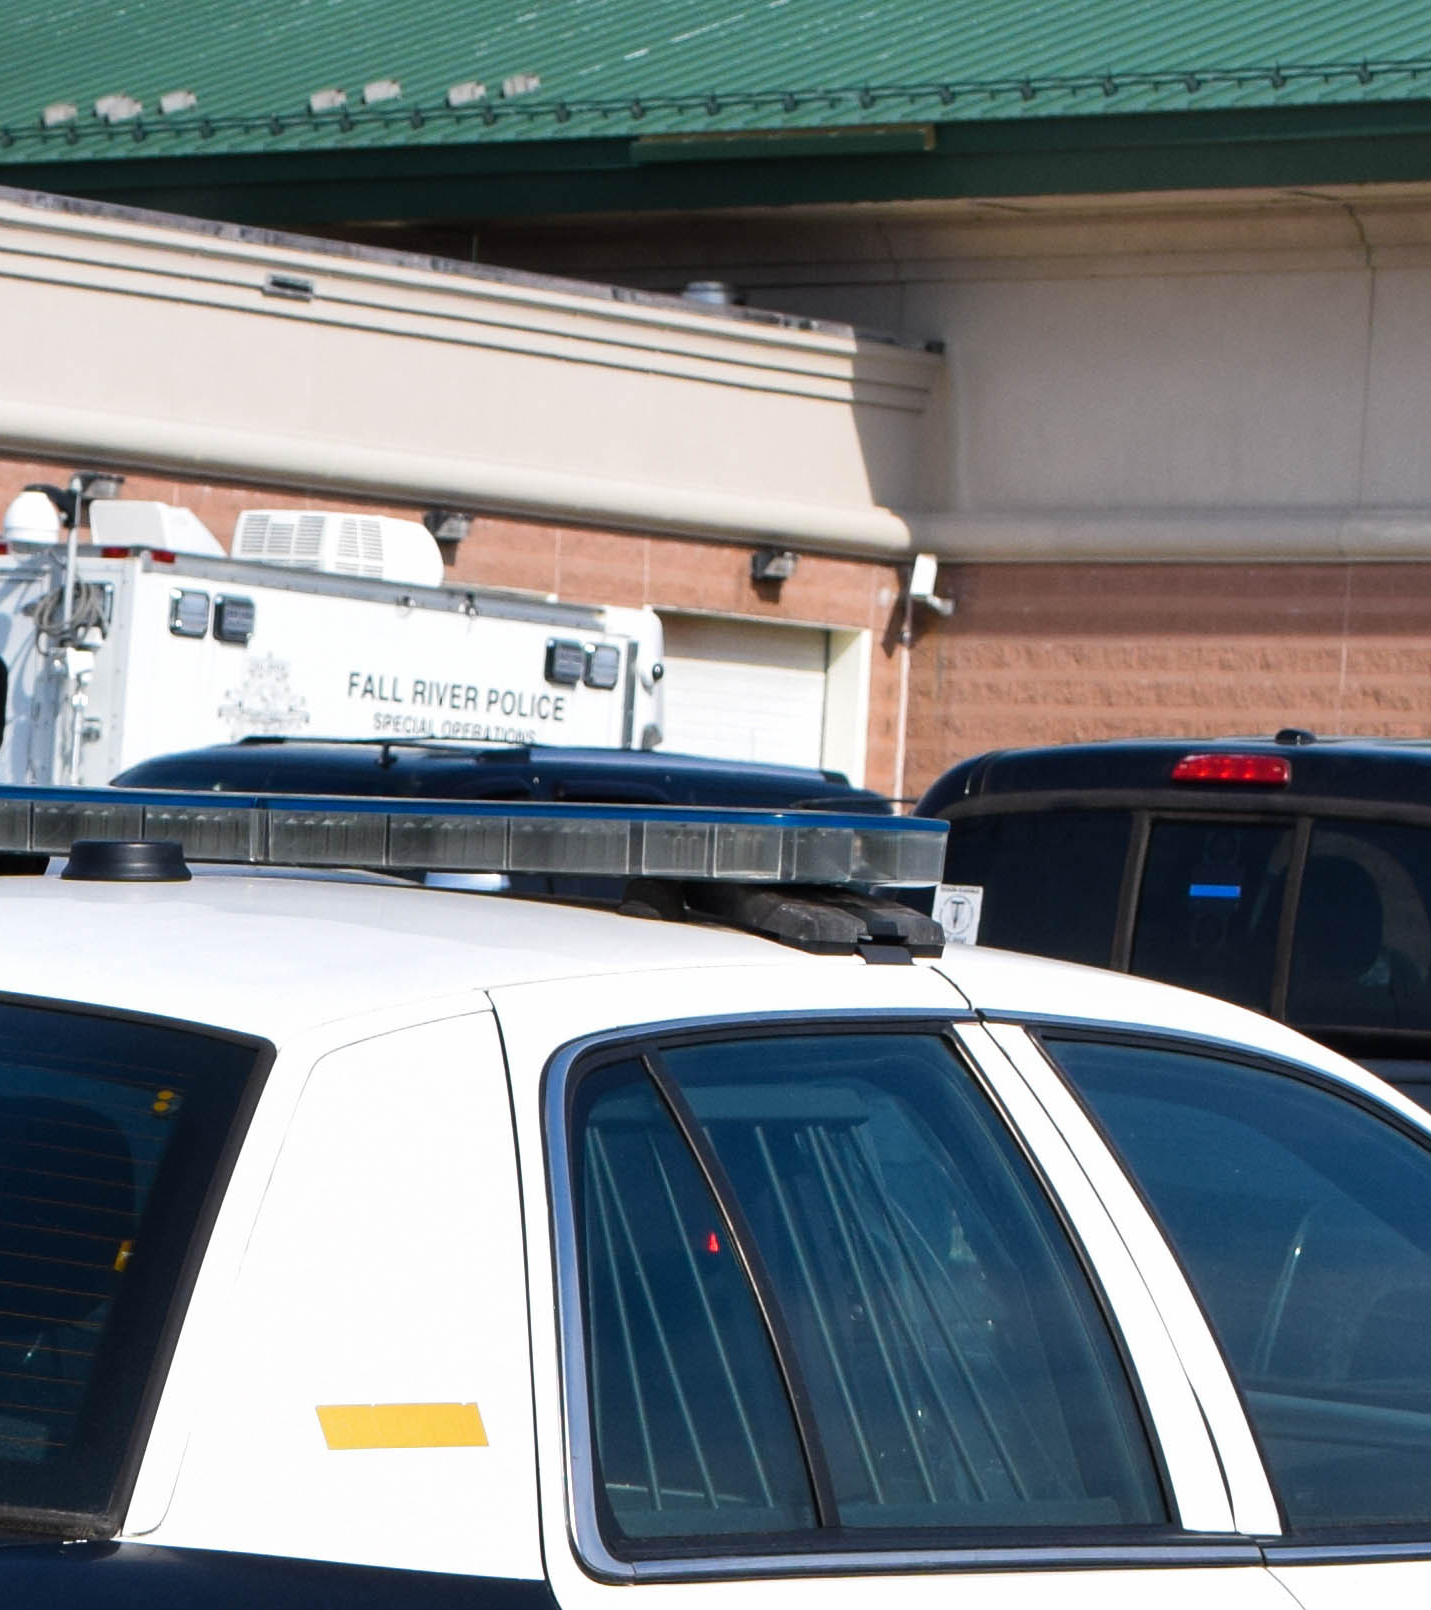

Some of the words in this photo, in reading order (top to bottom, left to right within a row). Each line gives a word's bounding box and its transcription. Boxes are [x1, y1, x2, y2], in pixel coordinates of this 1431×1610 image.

[347, 671, 403, 702] FALL
[411, 679, 479, 711] RIVER
[487, 688, 566, 722] POLICE
[372, 711, 434, 737] SPECIAL
